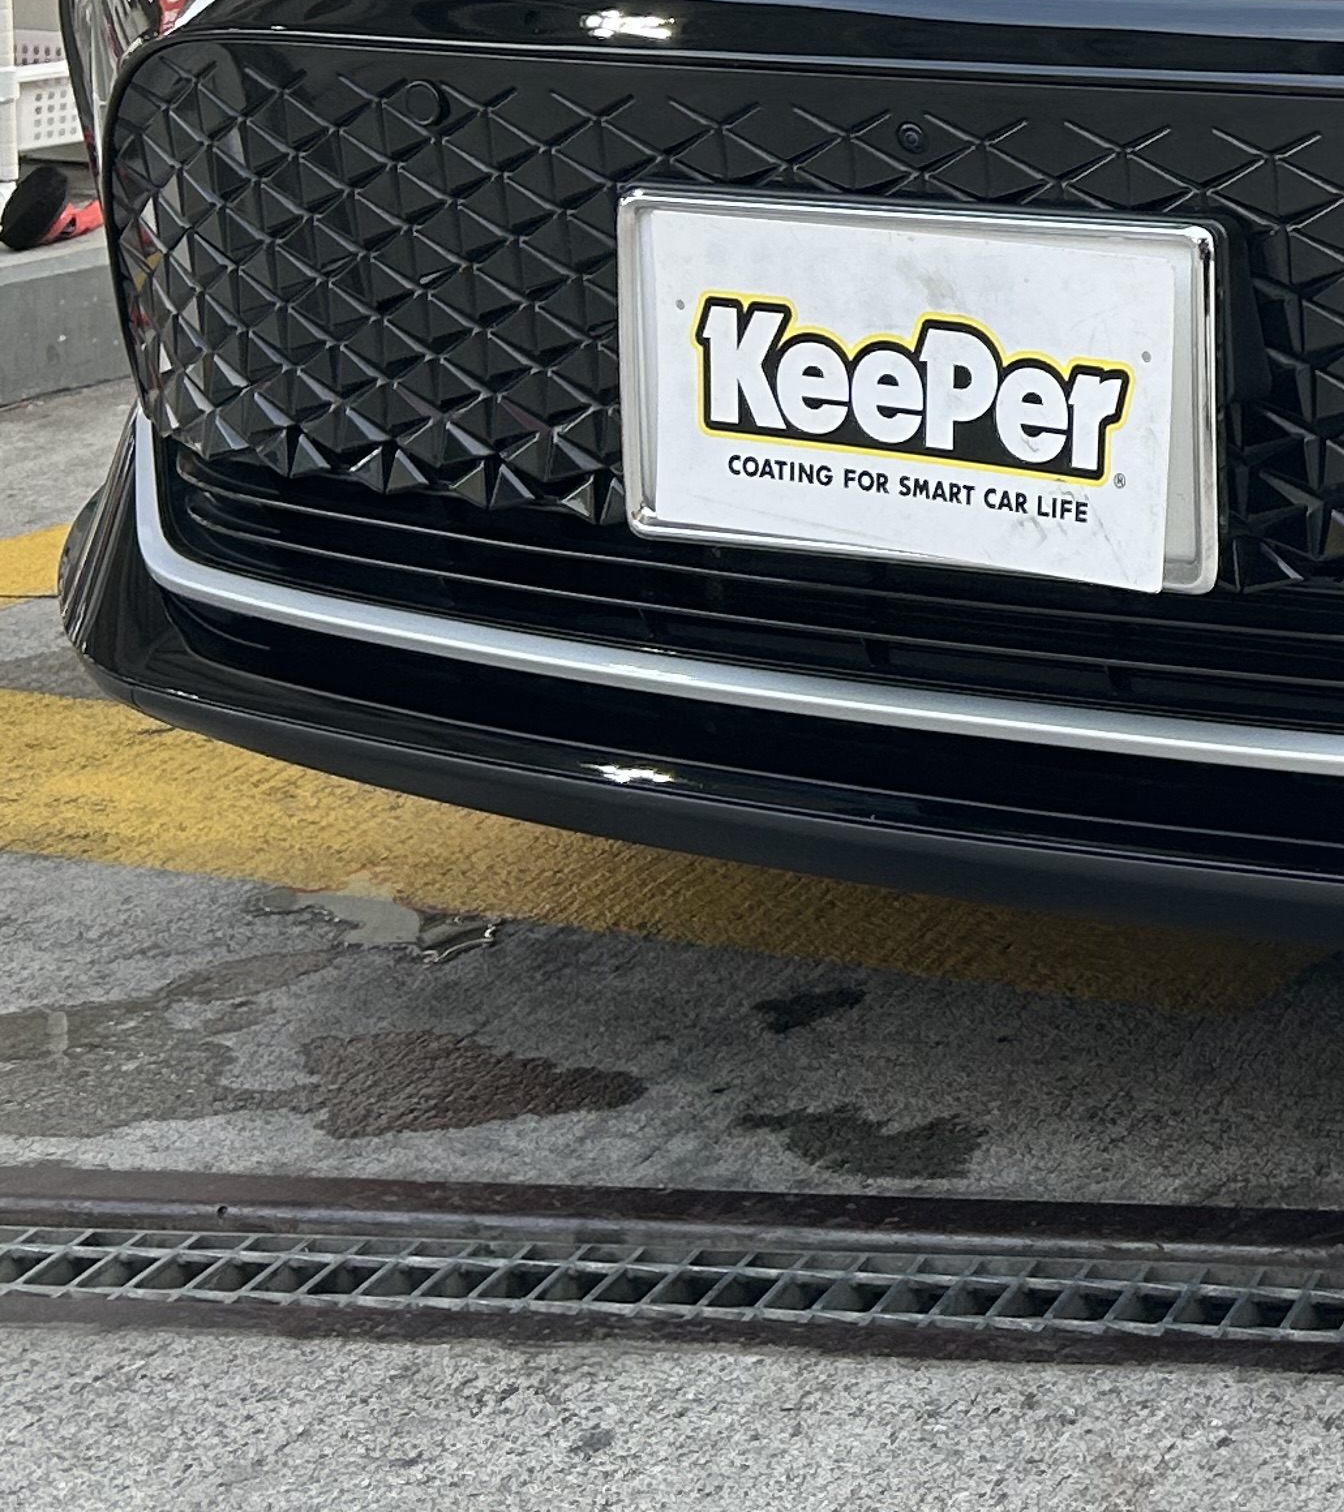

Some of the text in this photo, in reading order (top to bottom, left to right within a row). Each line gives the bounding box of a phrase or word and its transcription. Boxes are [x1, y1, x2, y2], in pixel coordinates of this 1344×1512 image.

[694, 292, 1133, 484] KeePer
[728, 454, 1089, 524] COATING FOR SMART CAR LIFE
